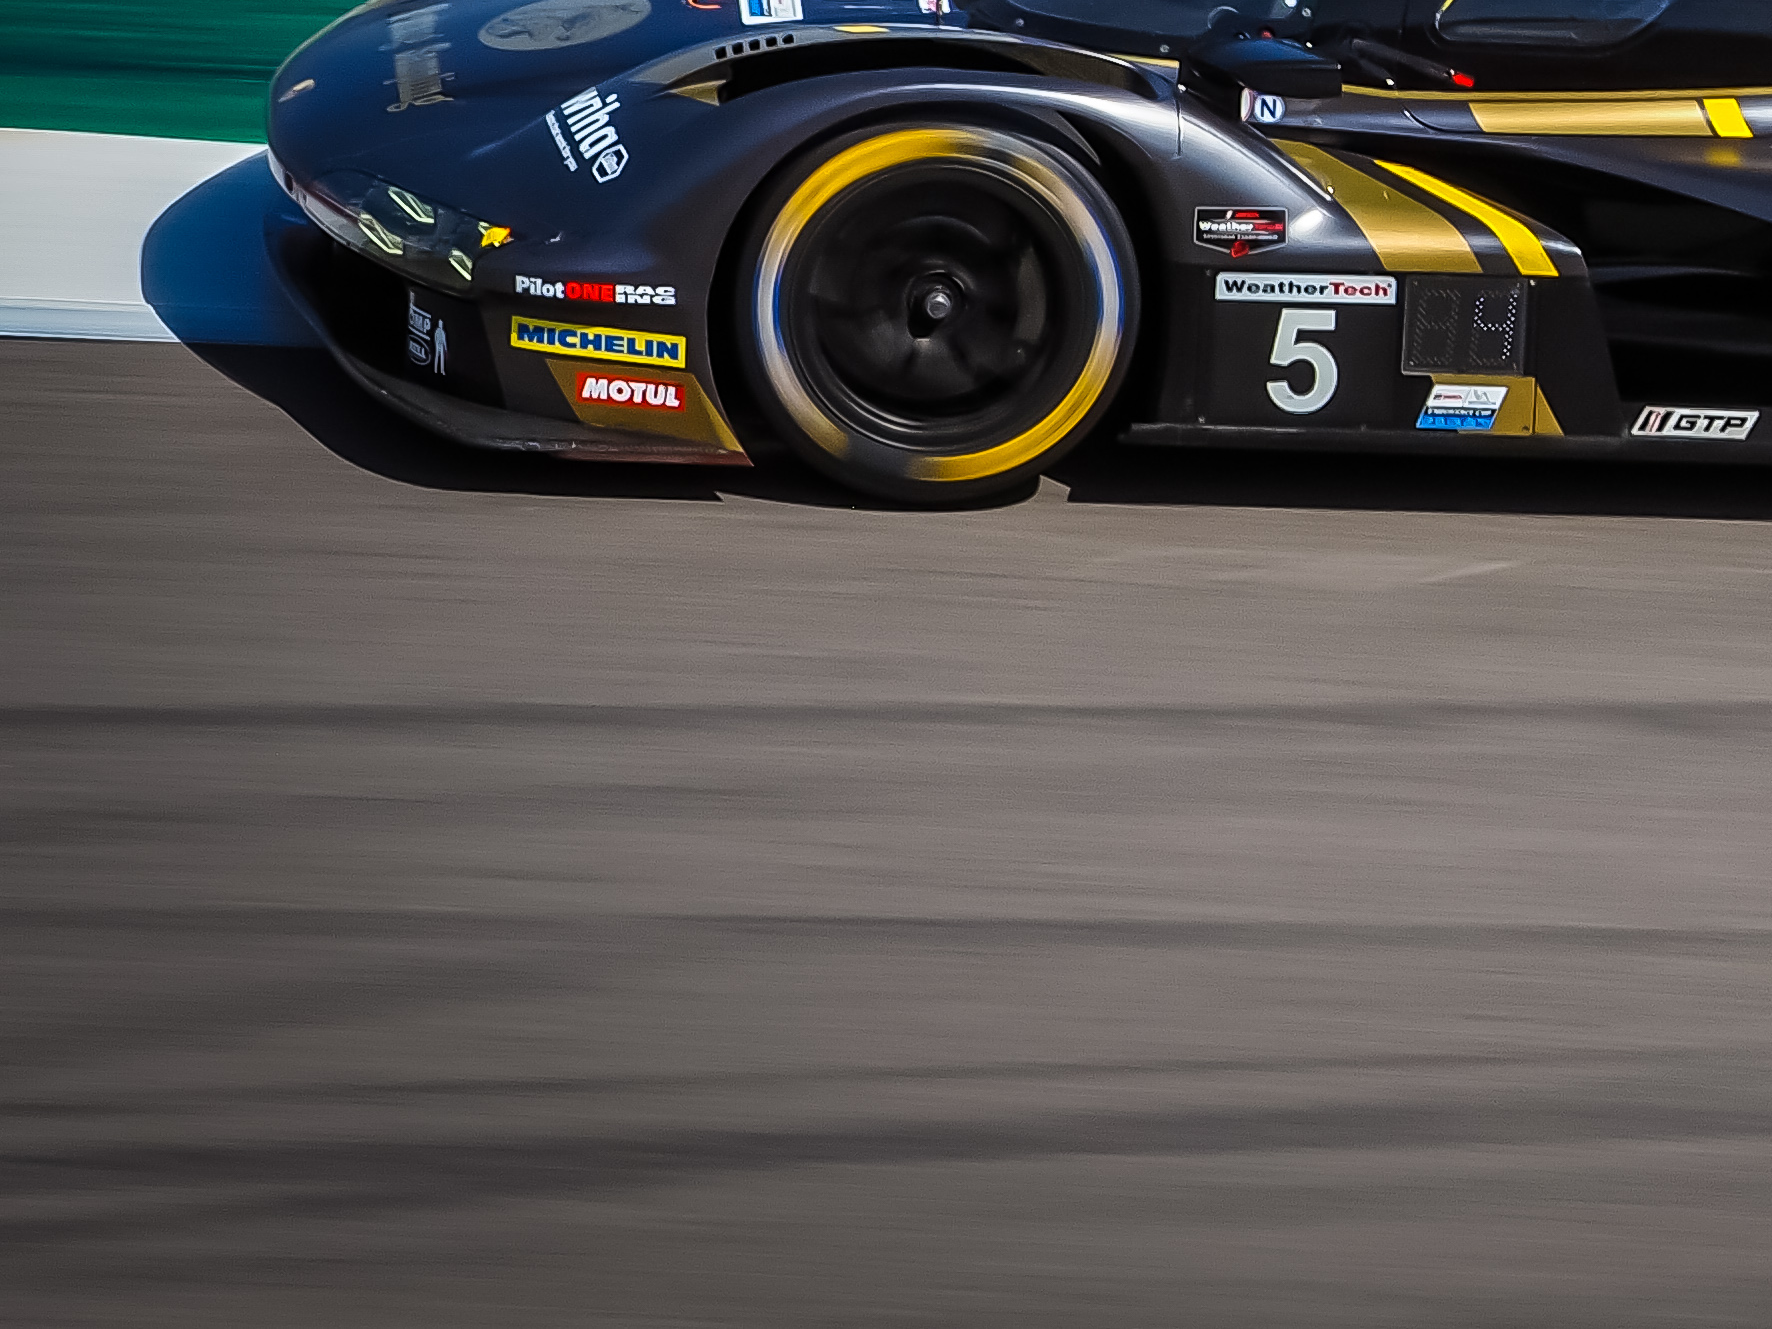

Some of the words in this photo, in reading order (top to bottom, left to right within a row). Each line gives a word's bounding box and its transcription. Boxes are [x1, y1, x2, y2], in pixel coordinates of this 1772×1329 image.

[1260, 97, 1277, 119] N
[1223, 279, 1391, 298] WeatherTech
[517, 323, 679, 361] MICHELIN
[1266, 309, 1338, 414] 5
[581, 377, 680, 408] MOTUL
[1673, 414, 1749, 433] GTP
